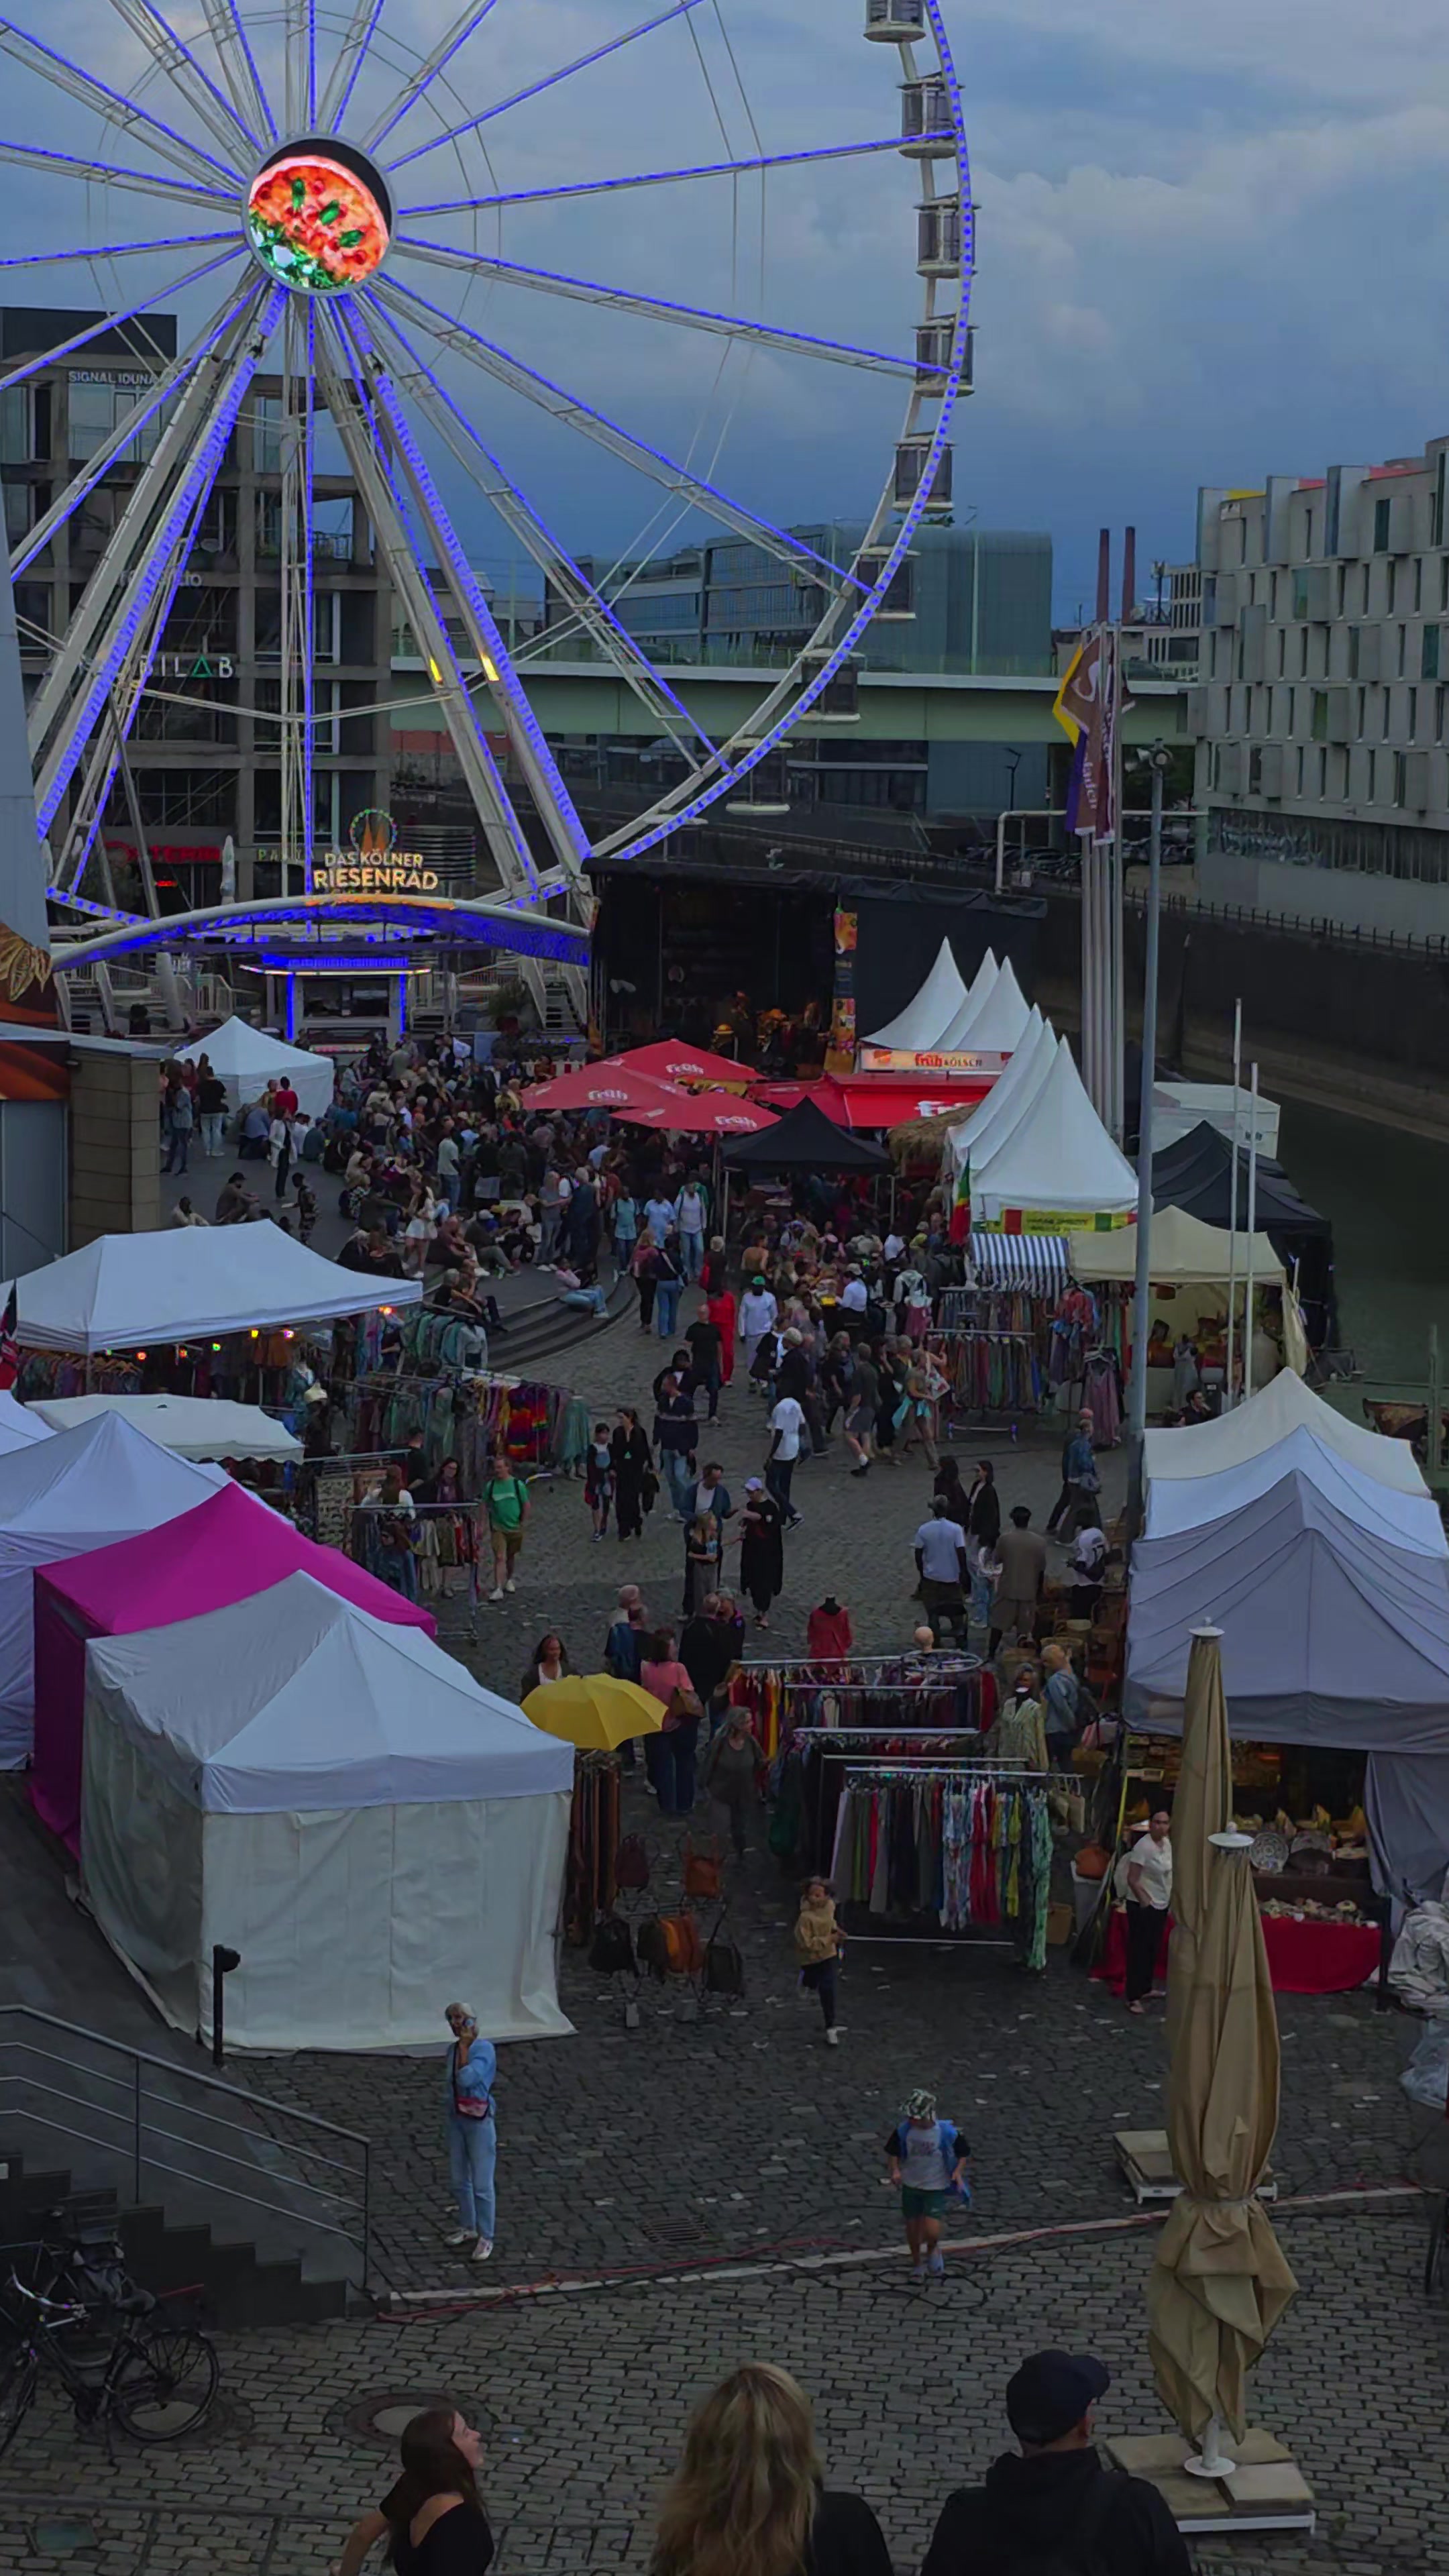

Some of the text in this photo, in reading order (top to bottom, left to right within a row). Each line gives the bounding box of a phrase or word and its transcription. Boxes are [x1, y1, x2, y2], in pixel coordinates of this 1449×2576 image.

[68, 371, 116, 383] SIGNAL
[325, 849, 424, 868] DAS KÖLNER
[313, 867, 439, 890] RIESENRAD
